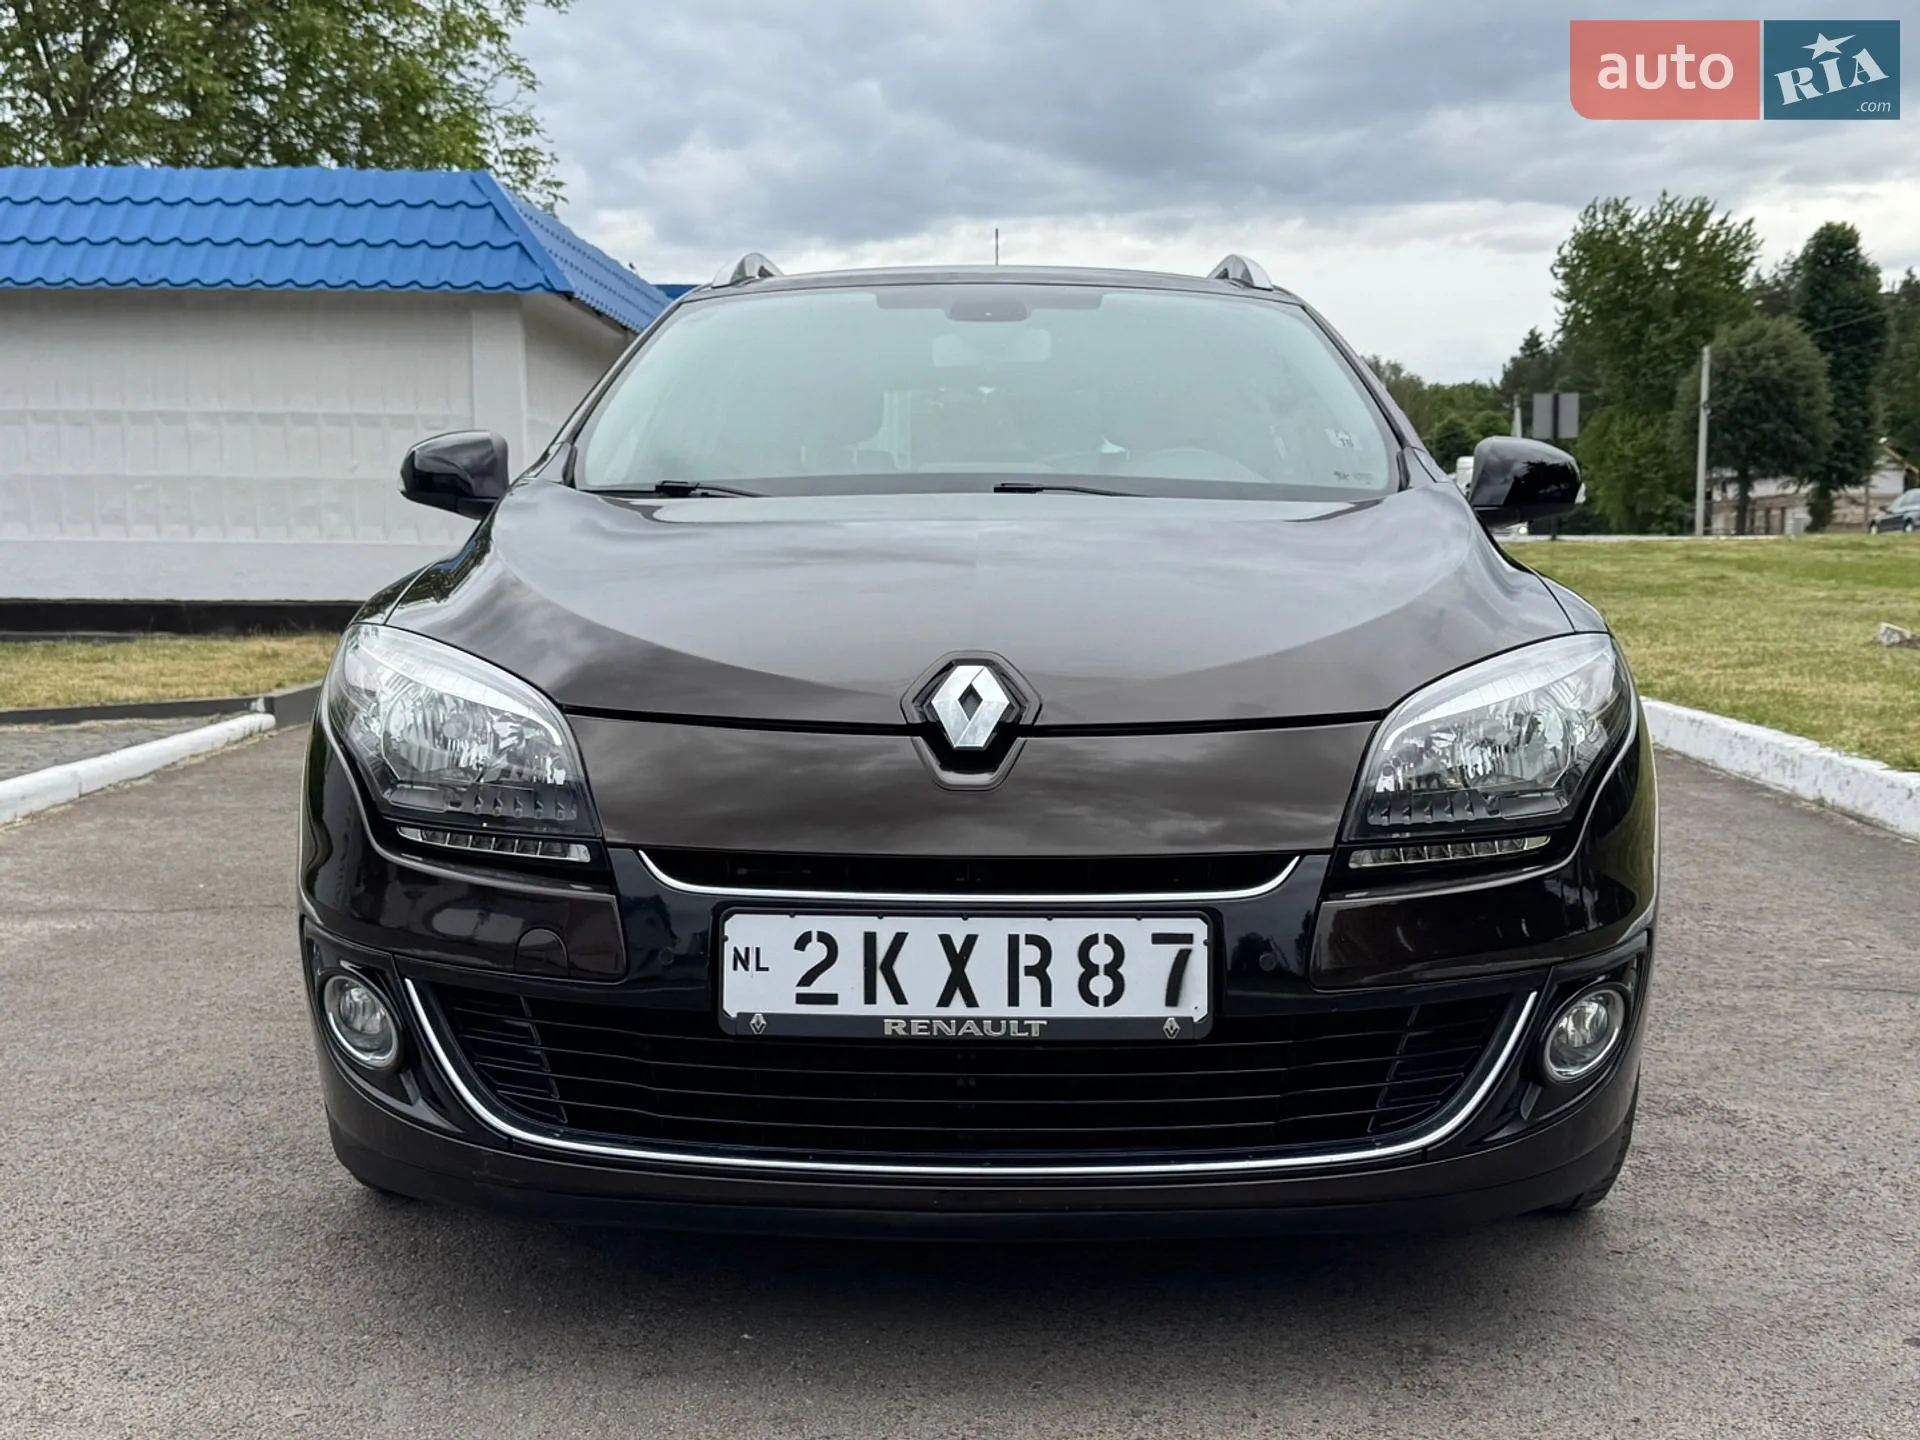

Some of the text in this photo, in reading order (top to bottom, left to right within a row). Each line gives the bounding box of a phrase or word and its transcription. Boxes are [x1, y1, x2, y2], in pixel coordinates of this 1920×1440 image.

[732, 930, 1194, 1007] NL 2KXR87
[884, 1019, 1047, 1037] RENAULT
